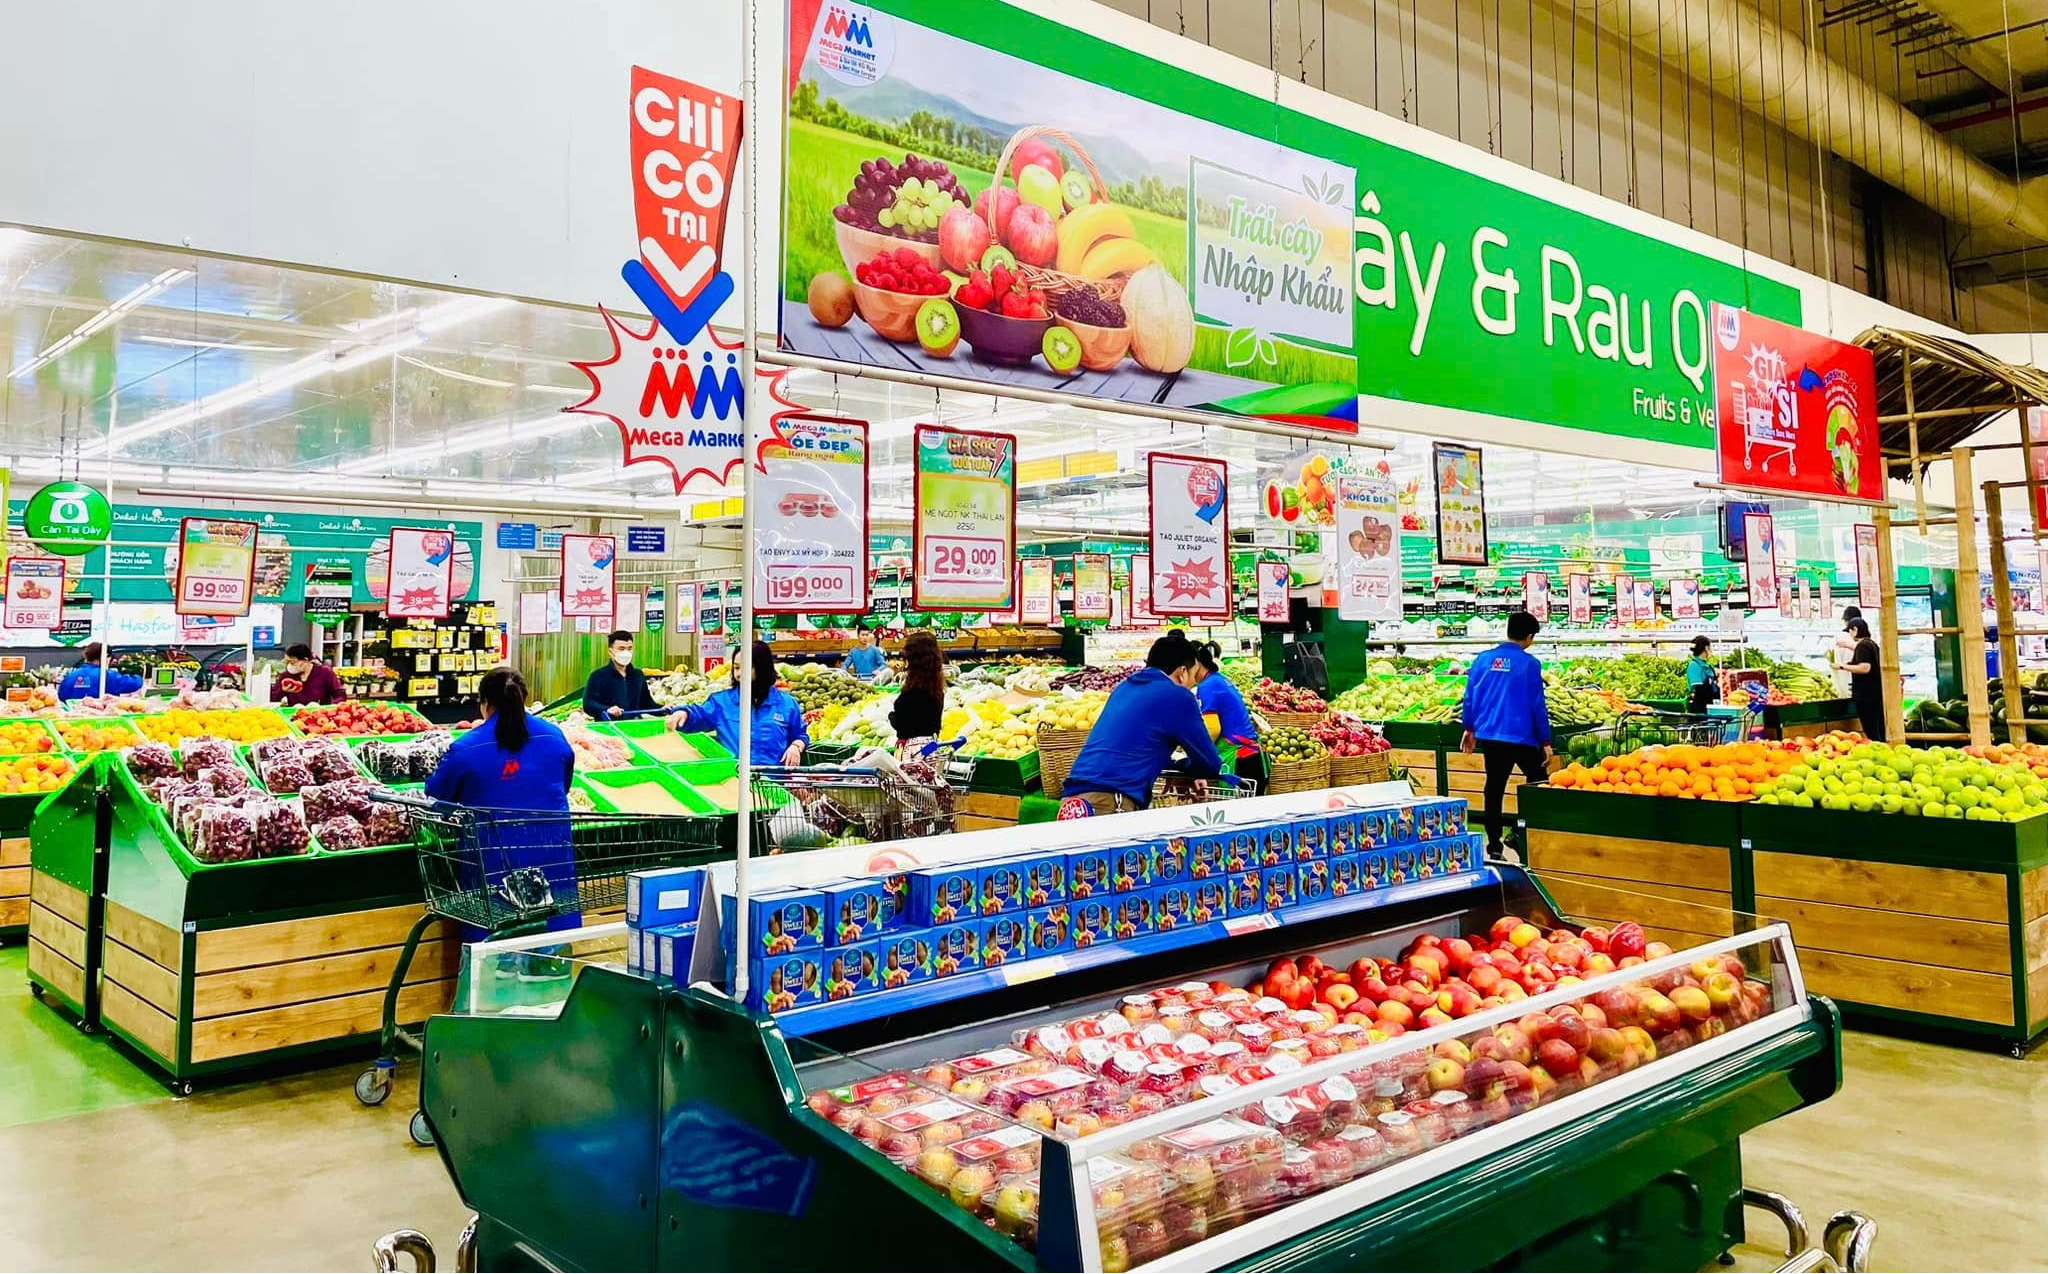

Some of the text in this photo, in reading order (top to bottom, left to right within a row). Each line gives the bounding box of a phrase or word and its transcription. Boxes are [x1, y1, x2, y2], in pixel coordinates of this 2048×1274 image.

[643, 149, 724, 208] CÓ
[662, 206, 707, 244] TẠI
[1228, 197, 1323, 266] Trái cây
[1203, 244, 1344, 315] Nhập Khẩu
[1355, 190, 1446, 356] ây
[1471, 226, 1520, 336] &
[1541, 244, 1653, 369] Rau
[1633, 387, 1715, 429] Fruits & Ve
[688, 429, 745, 447] Marke
